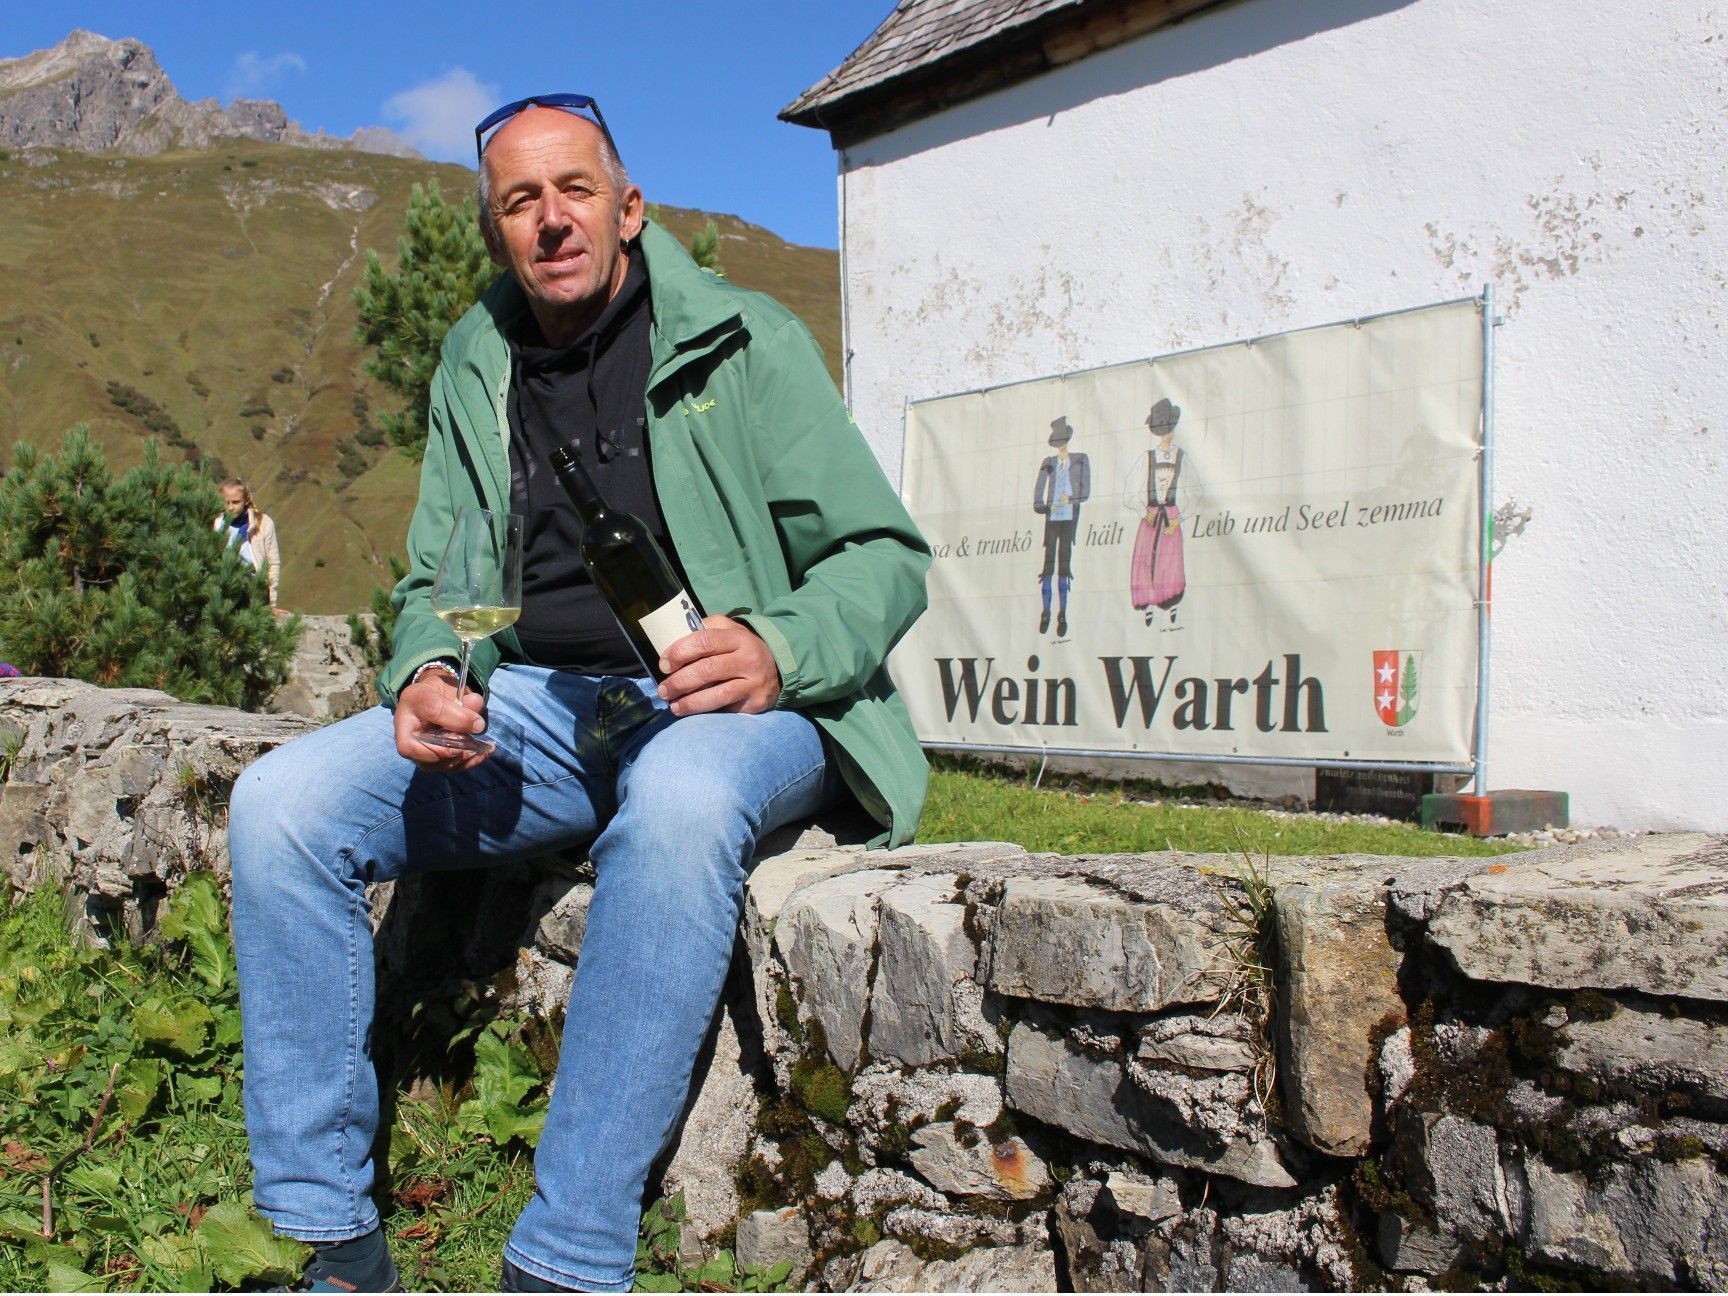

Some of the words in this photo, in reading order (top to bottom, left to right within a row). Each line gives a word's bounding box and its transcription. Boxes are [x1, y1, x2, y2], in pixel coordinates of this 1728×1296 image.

[928, 543, 950, 558] sa
[956, 535, 970, 558] &
[975, 530, 1033, 557] trunkô
[1085, 523, 1125, 547] hält
[1191, 511, 1236, 539] Leib
[1243, 506, 1291, 534] und
[1296, 500, 1350, 532] Seel
[1356, 496, 1444, 528] zemma
[933, 654, 1079, 726] Wein
[1097, 653, 1329, 733] Warth
